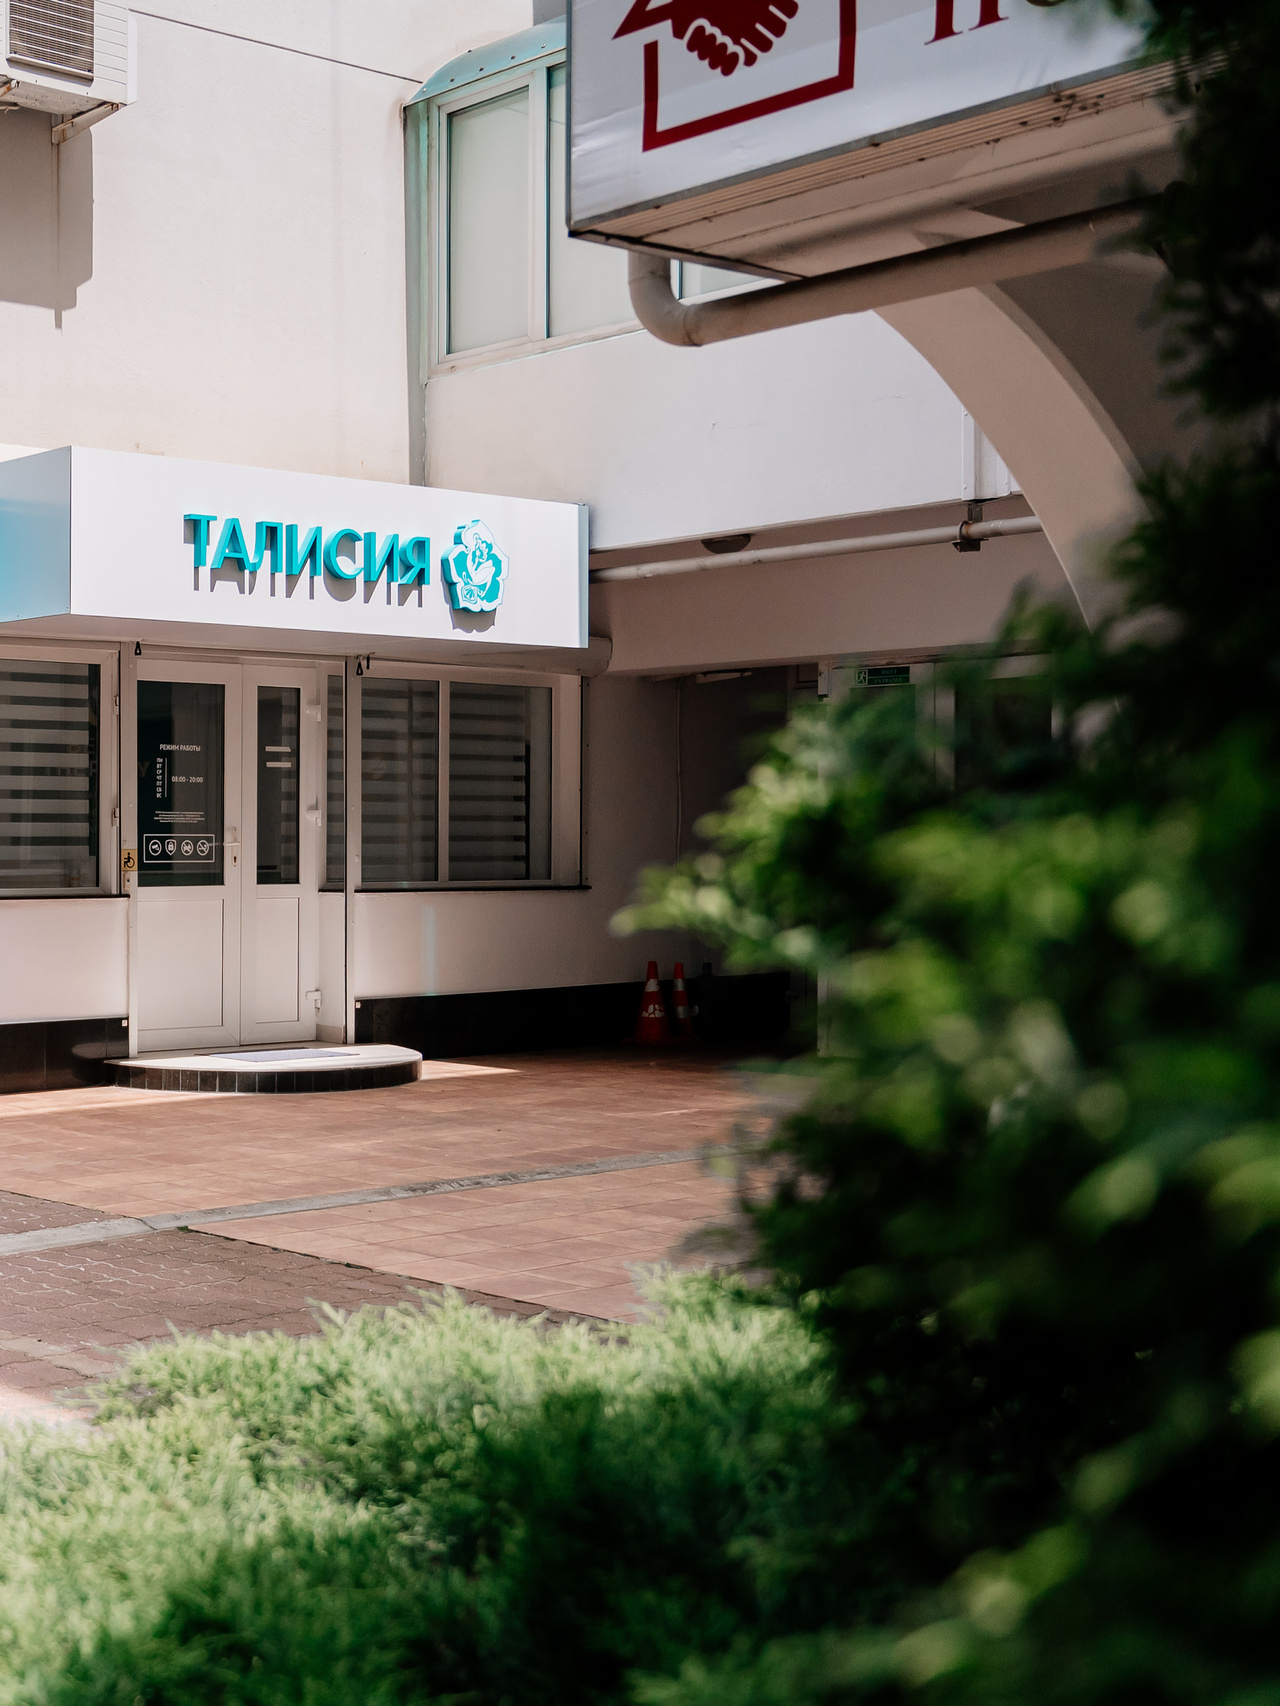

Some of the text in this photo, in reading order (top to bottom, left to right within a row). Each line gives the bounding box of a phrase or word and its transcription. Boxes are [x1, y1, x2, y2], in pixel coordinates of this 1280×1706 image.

[183, 513, 431, 587] ТАЛИСИЯ
[159, 743, 201, 752] РЕЖИМ РАБОТЫ
